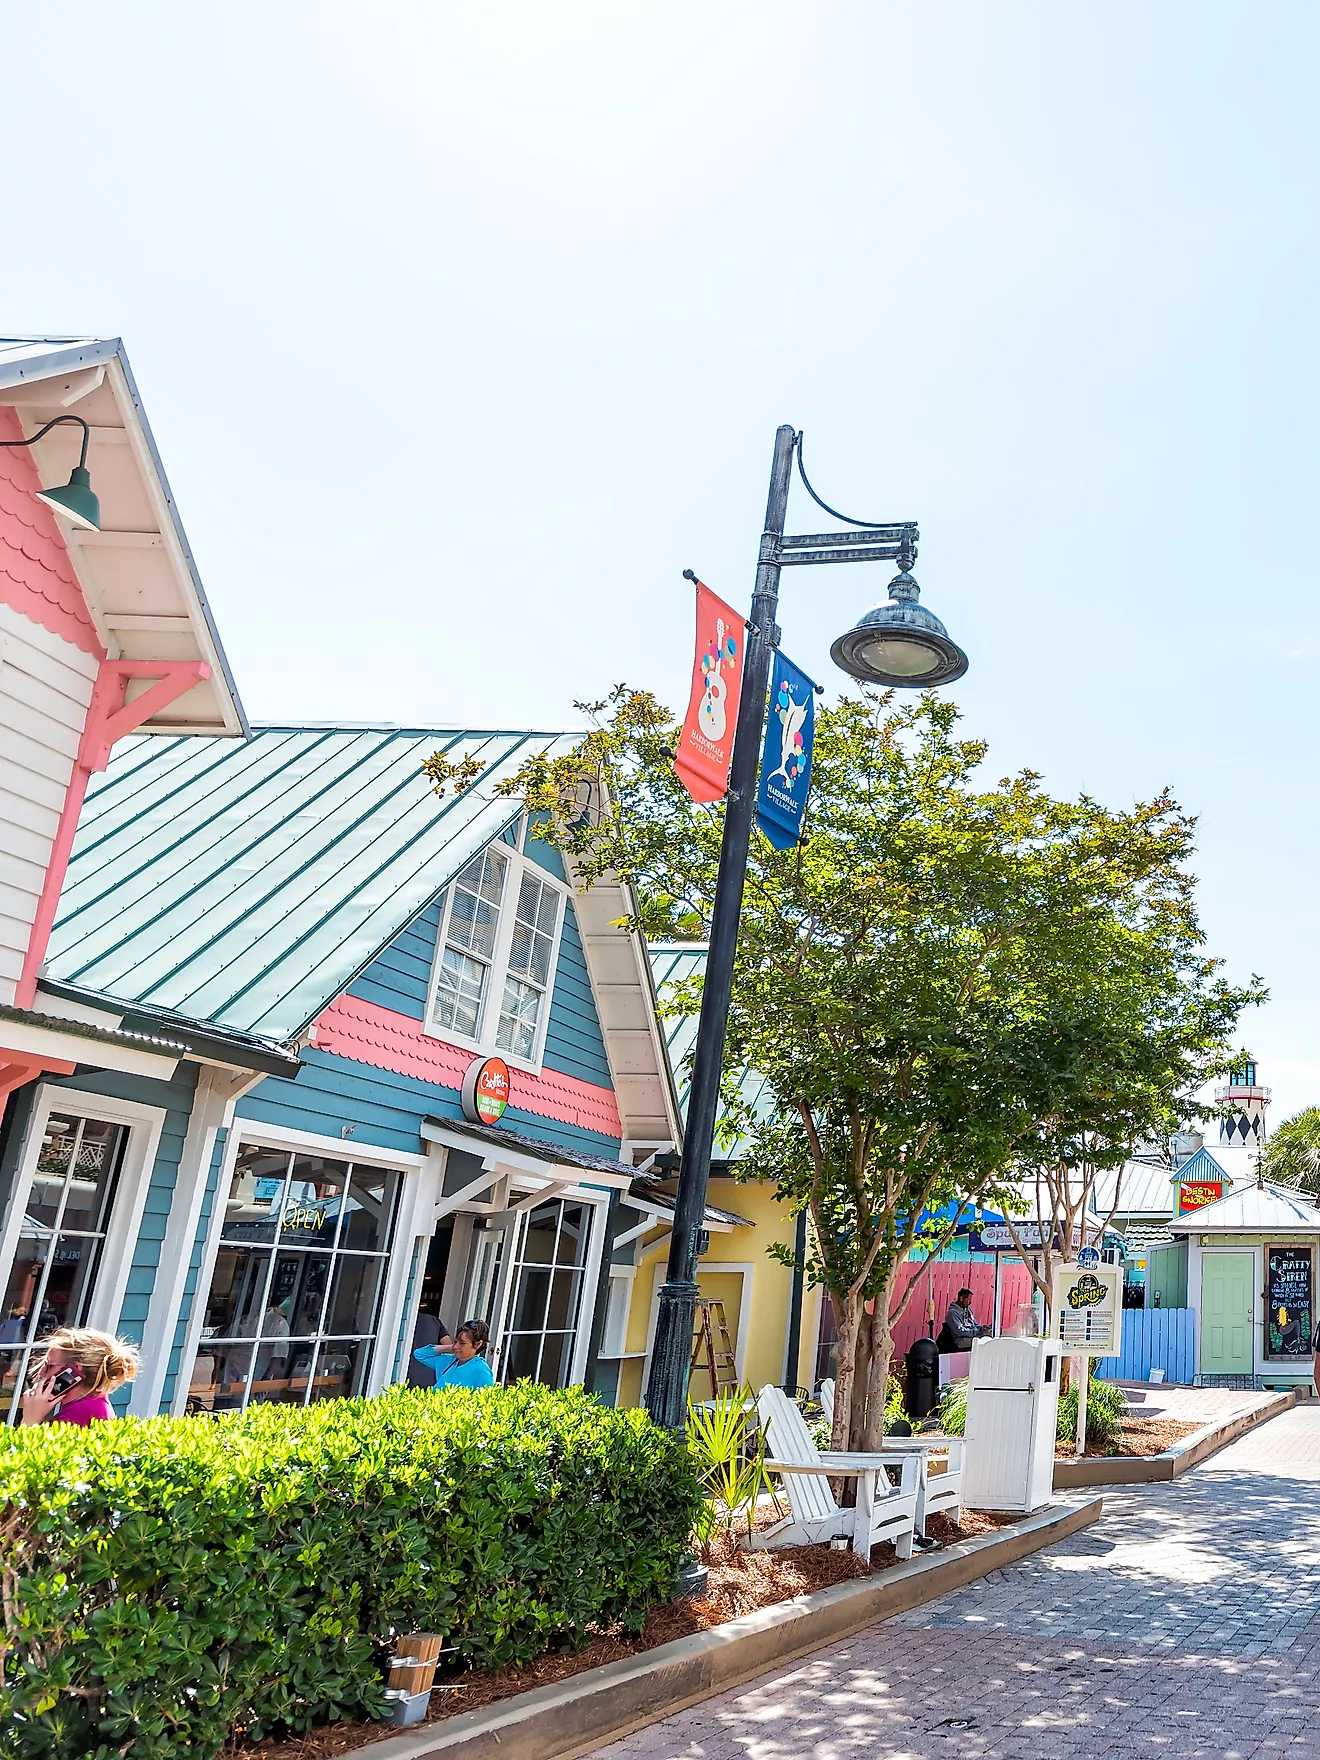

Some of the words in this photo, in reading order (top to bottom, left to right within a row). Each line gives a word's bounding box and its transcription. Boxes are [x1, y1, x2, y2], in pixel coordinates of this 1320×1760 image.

[691, 729, 725, 758] HARBORWALK
[695, 742, 717, 761] VILLAGE
[767, 783, 799, 809] HARBORWALK
[772, 795, 791, 813] VILLAGE
[1185, 1187, 1216, 1196] DESTIN
[283, 1204, 326, 1231] OPEN
[1270, 1255, 1310, 1271] CRAFTY
[1276, 1269, 1307, 1283] SIREN
[1071, 1287, 1106, 1308] SPRING
